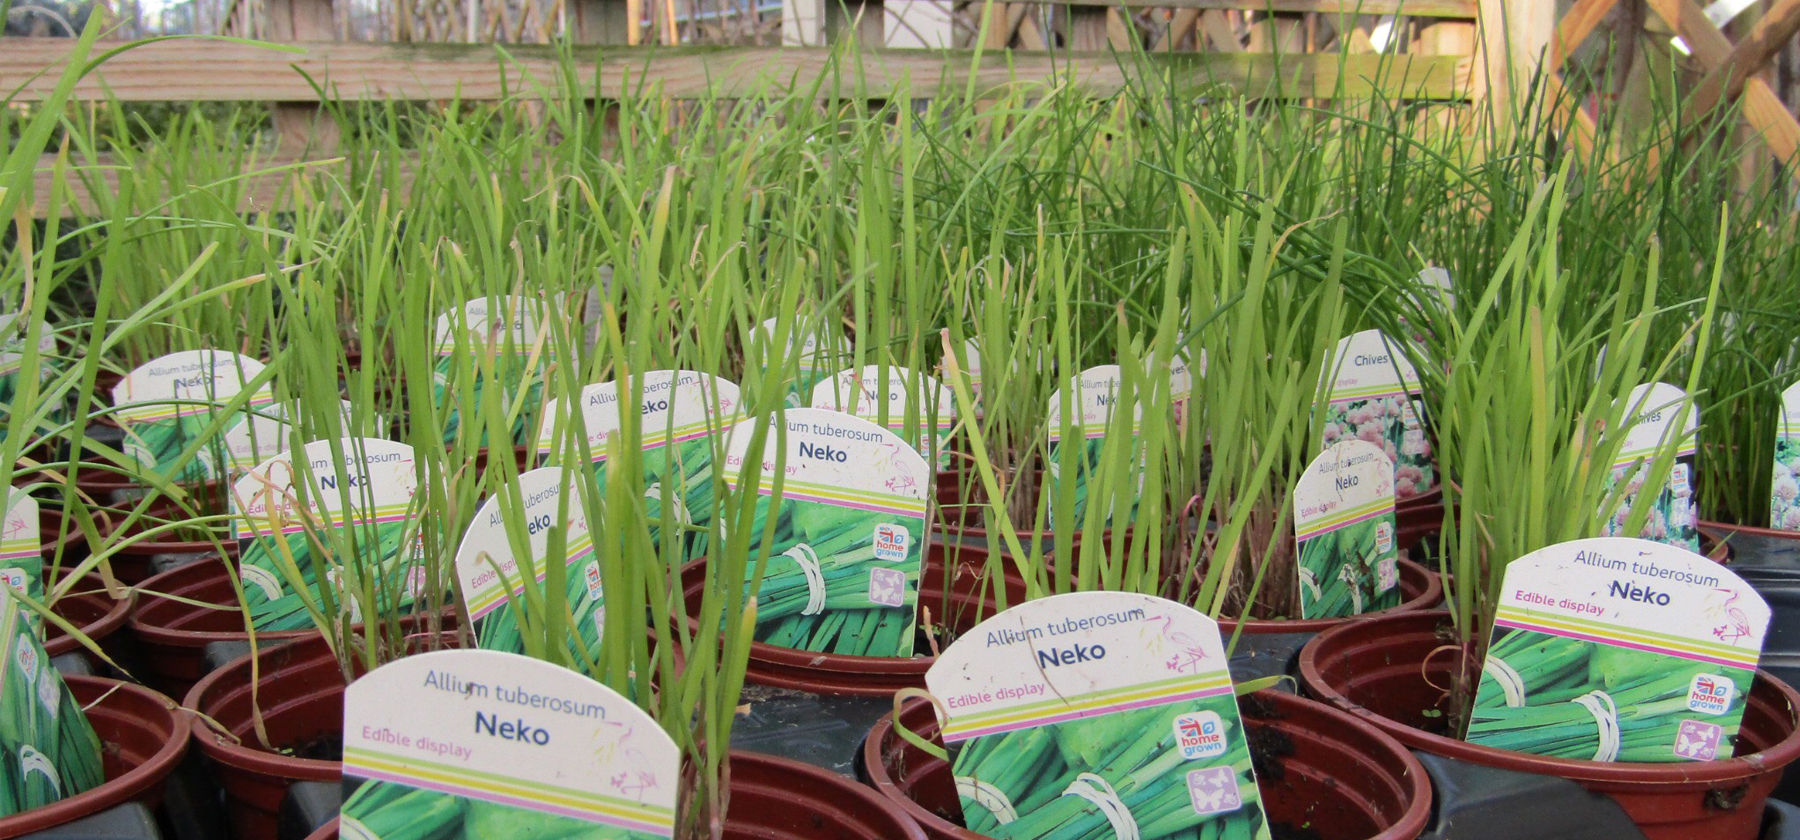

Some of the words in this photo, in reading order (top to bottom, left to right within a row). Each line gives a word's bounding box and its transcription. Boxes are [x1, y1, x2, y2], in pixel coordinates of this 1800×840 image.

[1355, 354, 1388, 366] Chives
[590, 391, 626, 406] Alliu
[626, 400, 668, 417] eko
[769, 415, 809, 433] Aium
[813, 423, 883, 443] tuberosum
[799, 441, 848, 463] Neko
[762, 460, 797, 475] disay
[1335, 475, 1359, 491] Neko
[876, 549, 904, 558] grown
[877, 540, 904, 551] home
[471, 568, 496, 588] Edible
[1574, 550, 1627, 571] Allium
[1632, 560, 1719, 588] tuberosum
[1515, 590, 1555, 607] Edible
[1559, 597, 1605, 616] display
[1609, 580, 1671, 606] Neko
[986, 626, 1043, 648] Allium
[1047, 607, 1145, 636] tuberosum
[1037, 643, 1106, 668] Neko
[423, 670, 488, 698] Allium
[496, 686, 606, 719] tuberosum
[948, 689, 992, 708] Edible
[996, 683, 1045, 700] display
[1692, 690, 1725, 704] home
[1690, 700, 1724, 711] grown
[475, 711, 550, 746] Neko
[362, 726, 411, 747] Edible
[416, 736, 472, 761] display
[1181, 734, 1219, 747] home
[1184, 742, 1222, 757] grown
